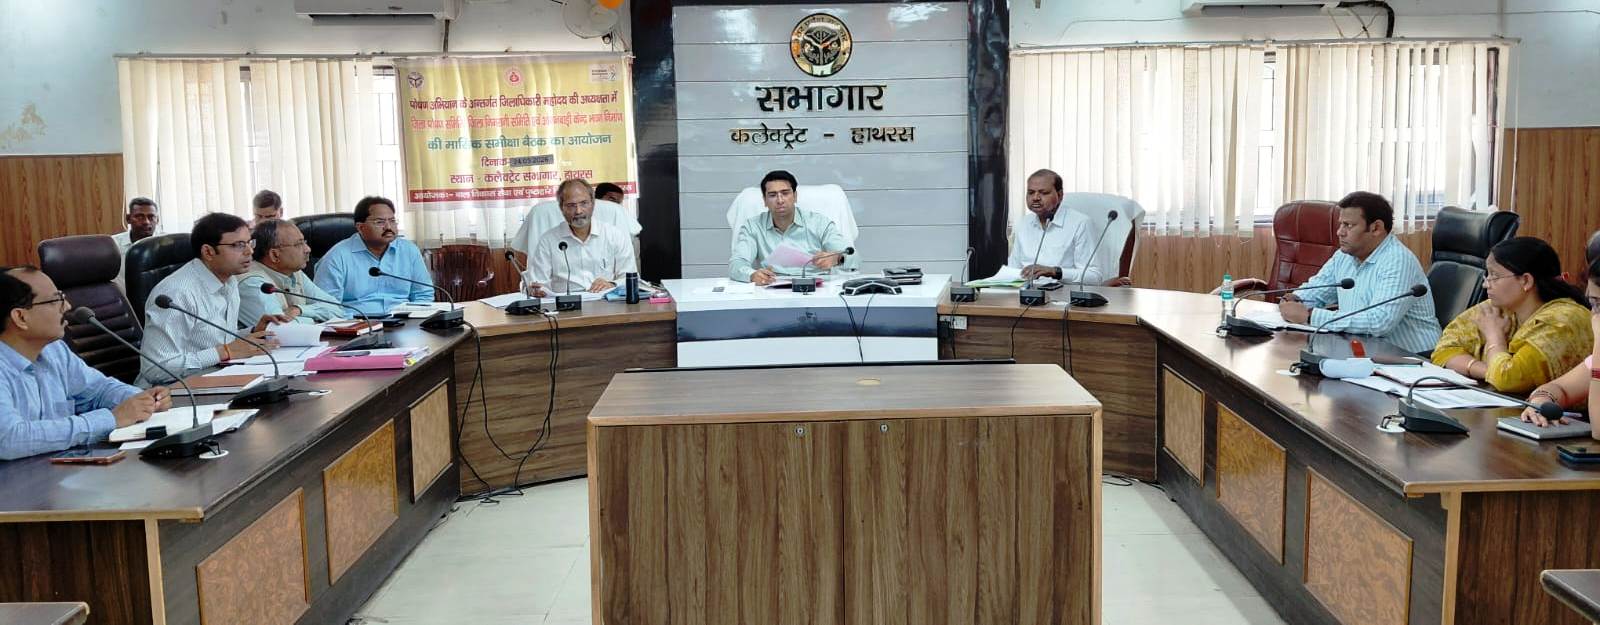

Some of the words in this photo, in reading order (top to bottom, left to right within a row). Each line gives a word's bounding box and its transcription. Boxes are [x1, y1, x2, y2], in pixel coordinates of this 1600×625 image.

[409, 97, 428, 111] पोषण
[499, 94, 541, 108] जिलाधिकारी
[543, 92, 568, 107] महोदय
[569, 91, 579, 105] की
[611, 90, 619, 103] में
[755, 84, 887, 111] सभागार
[428, 137, 442, 150] की
[484, 135, 519, 149] समीक्षा
[521, 134, 547, 147] बैठक
[550, 136, 565, 146] का
[567, 132, 613, 145] आयोजन
[729, 123, 808, 149] कलेक्ट्रेट
[851, 126, 916, 144] हाथरस
